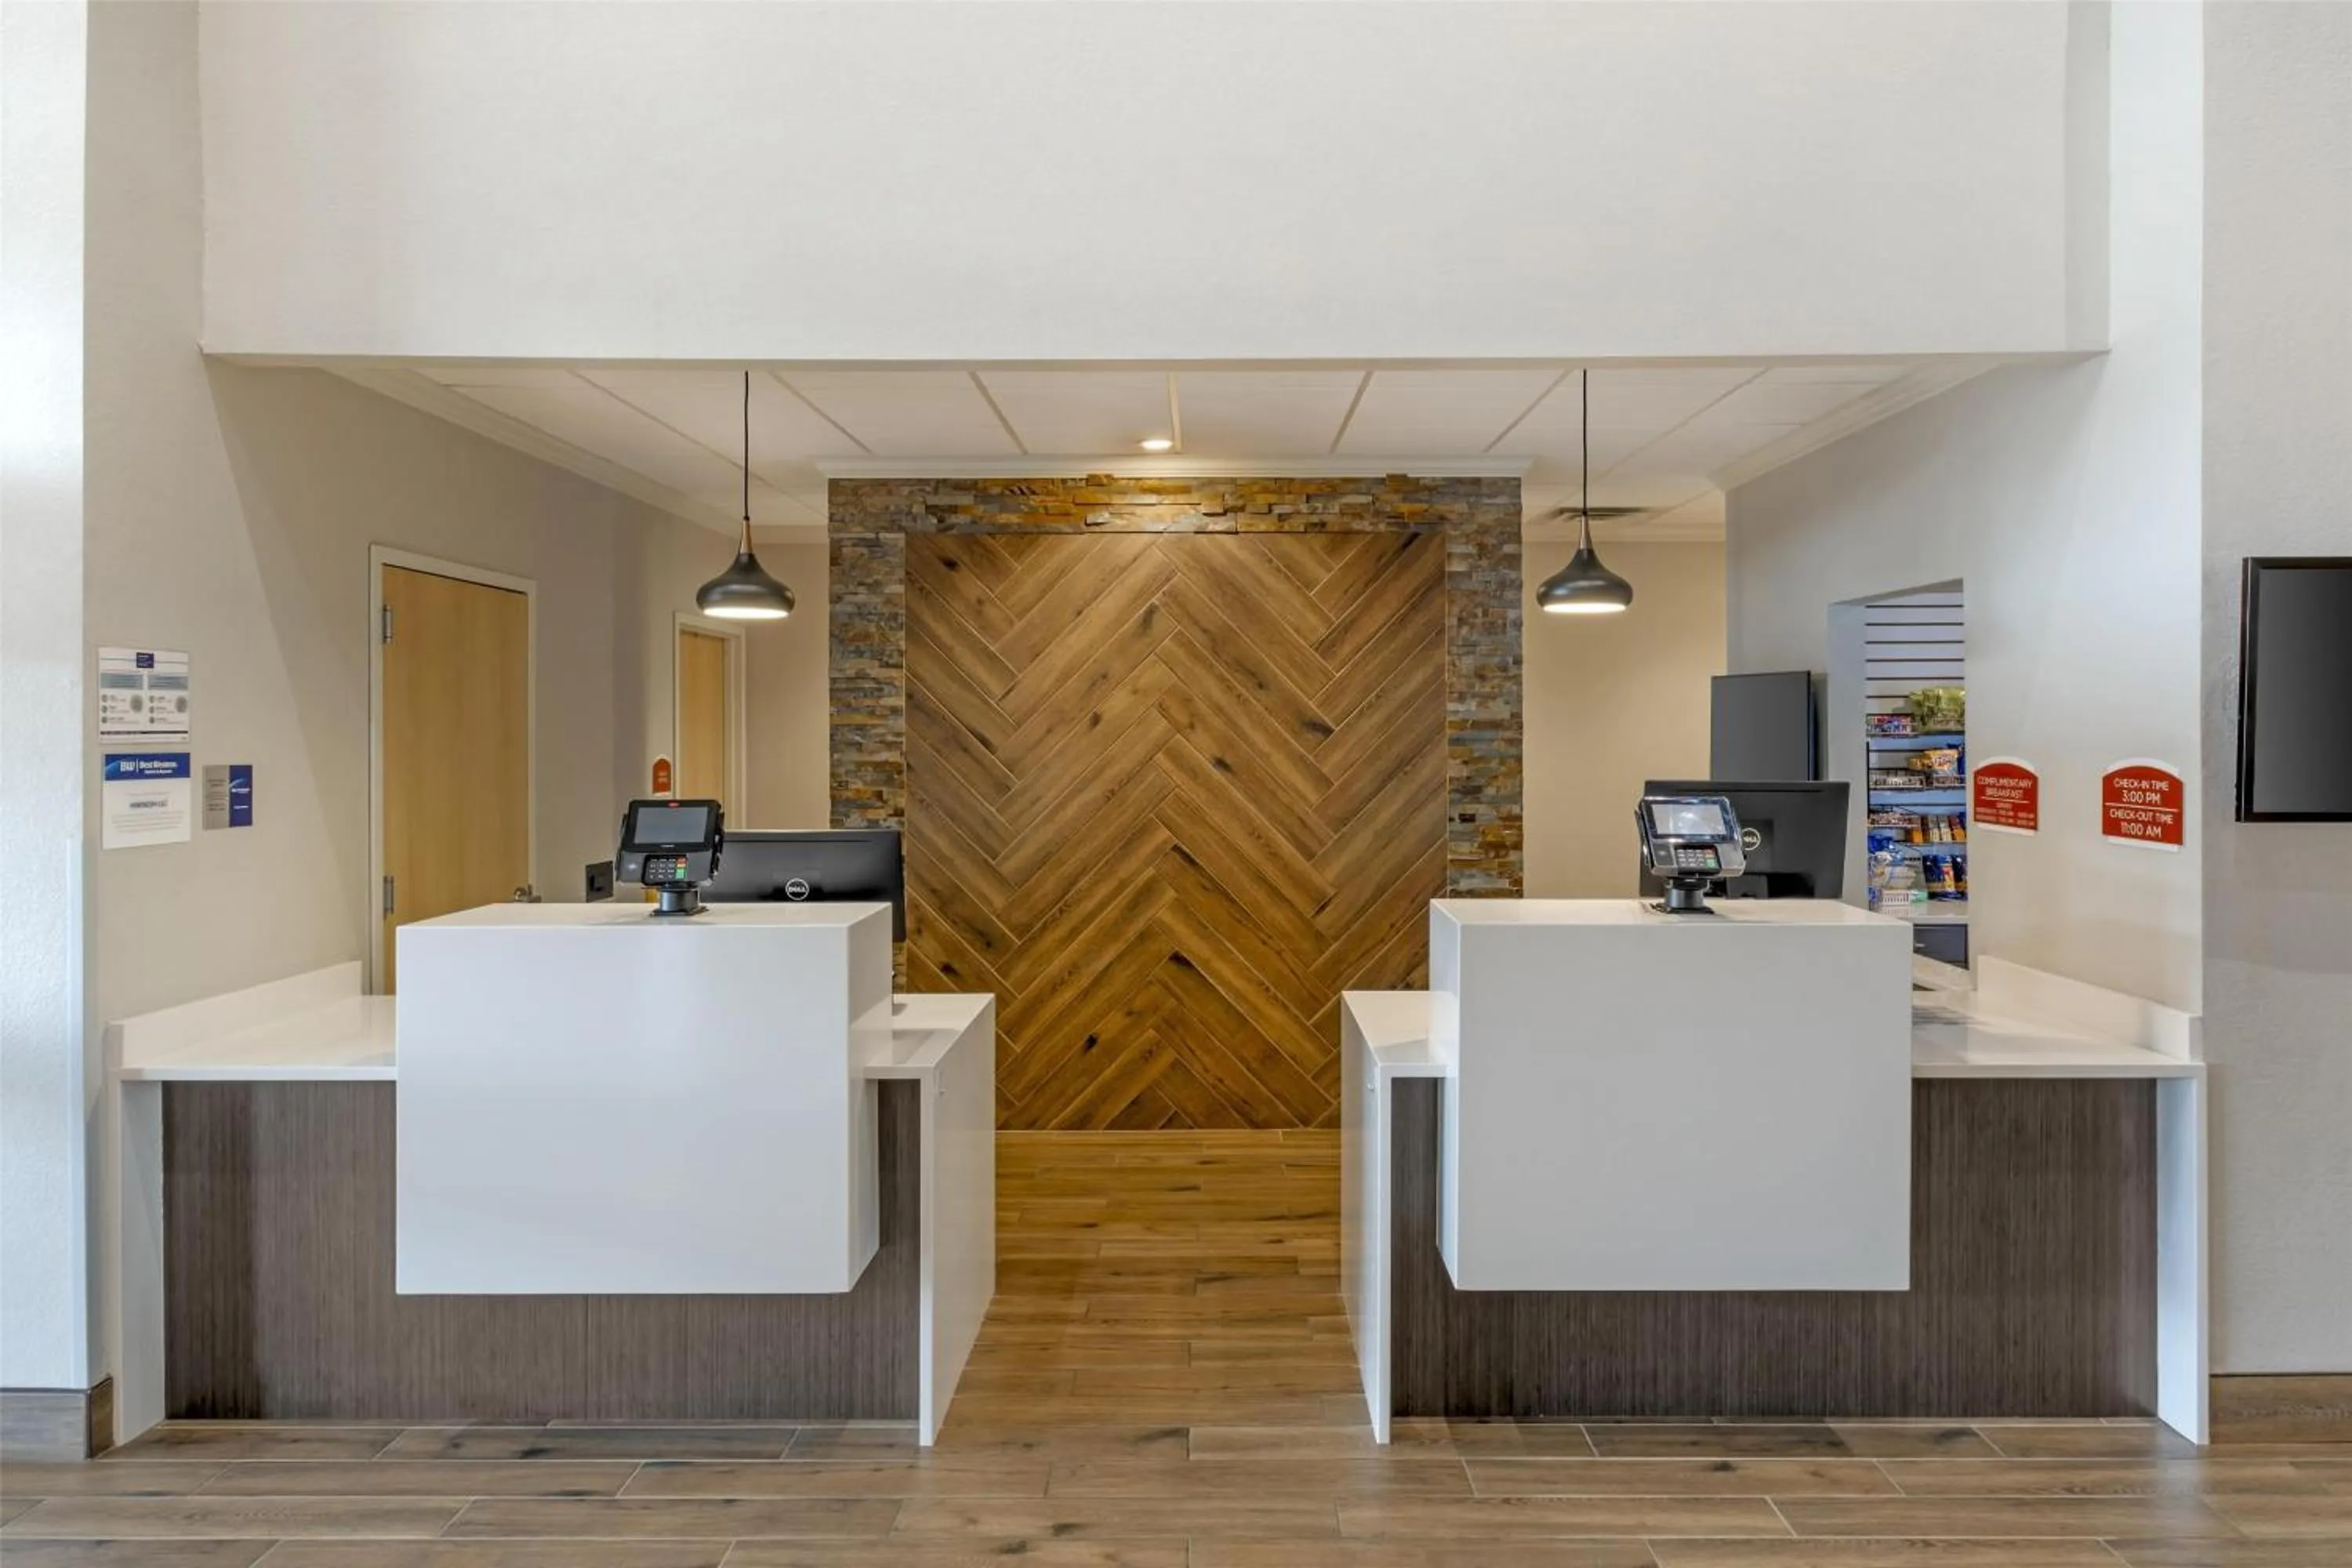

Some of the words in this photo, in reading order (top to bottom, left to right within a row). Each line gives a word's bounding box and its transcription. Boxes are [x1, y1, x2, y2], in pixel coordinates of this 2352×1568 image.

[1977, 775, 2033, 788] COMPLIMENTARY
[2114, 778, 2150, 789] CHECK-IN
[2151, 780, 2169, 791] TIME
[1985, 786, 2024, 798] BREAKFAST
[2122, 789, 2144, 803] 3:00
[2146, 792, 2161, 804] PM
[2110, 808, 2154, 822] CHECK-OUT
[2155, 813, 2174, 824] TIME
[2121, 822, 2144, 835] 11:00
[2145, 824, 2161, 838] AM
